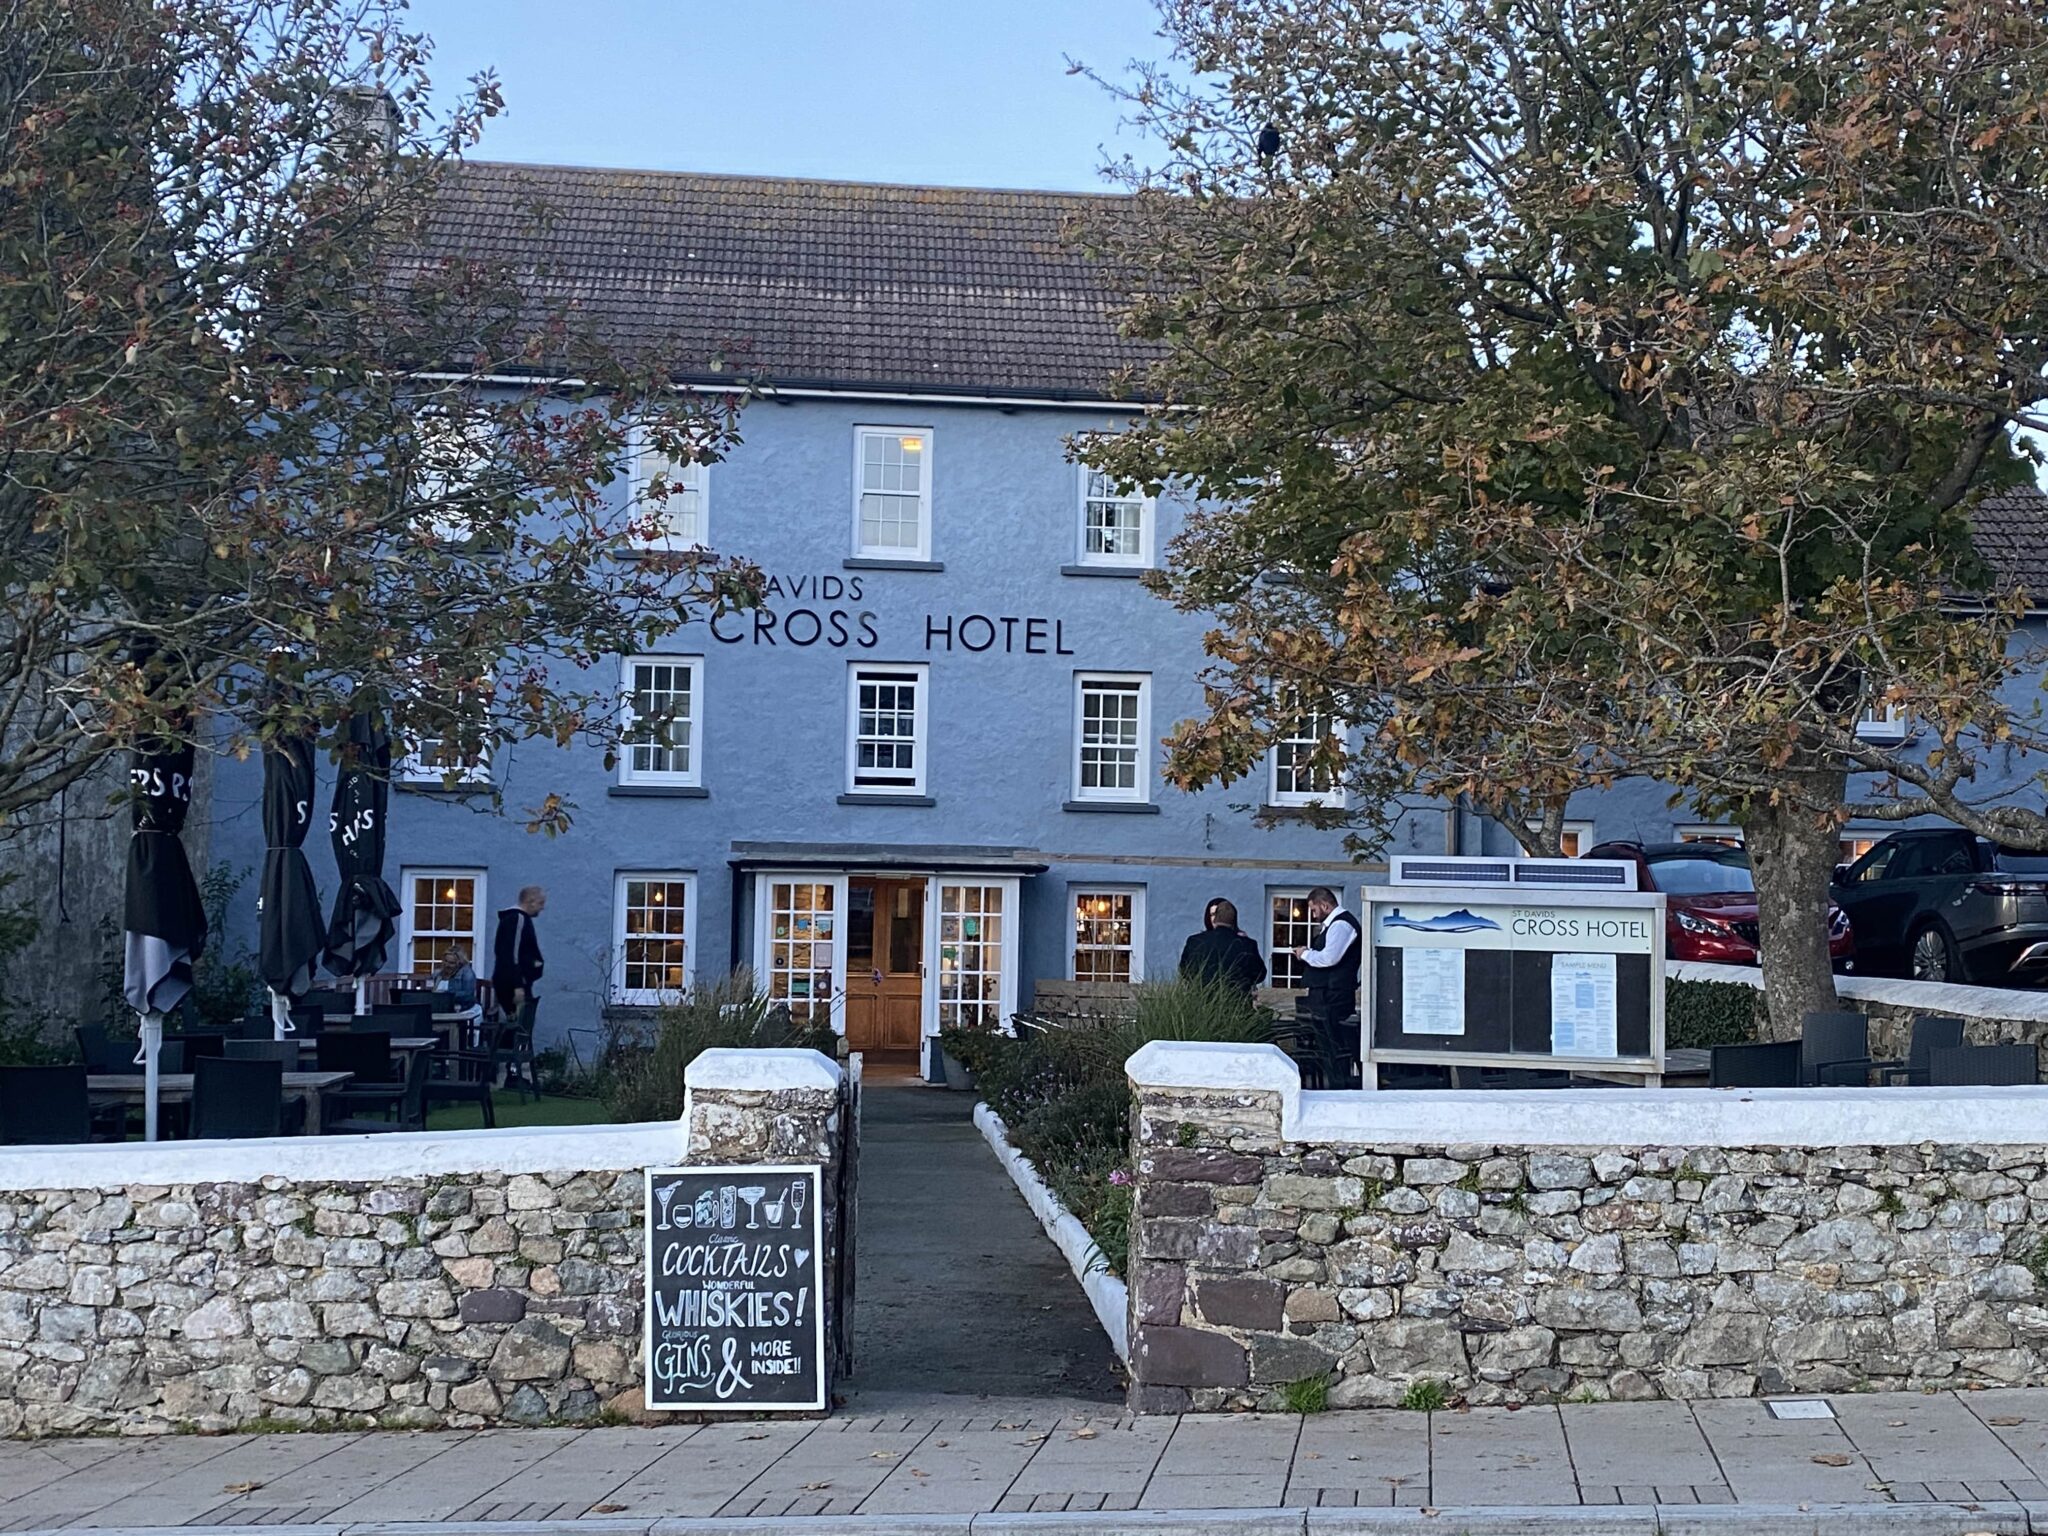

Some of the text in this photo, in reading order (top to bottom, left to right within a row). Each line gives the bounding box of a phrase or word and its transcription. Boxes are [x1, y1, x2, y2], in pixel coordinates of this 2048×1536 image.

[766, 574, 864, 601] AVIDS
[710, 607, 1074, 655] CROSS HOTEL
[1524, 910, 1556, 918] DAVIDS
[1512, 918, 1648, 938] CROSS HOTEL
[1561, 961, 1585, 969] SAMPLE
[662, 1242, 790, 1278] COCKTAILS
[702, 1280, 756, 1290] WONDERFUL
[655, 1287, 808, 1328] WHISKIES!
[750, 1339, 792, 1357] MORE
[715, 1337, 754, 1399] &
[751, 1357, 802, 1375] INSIDE!!
